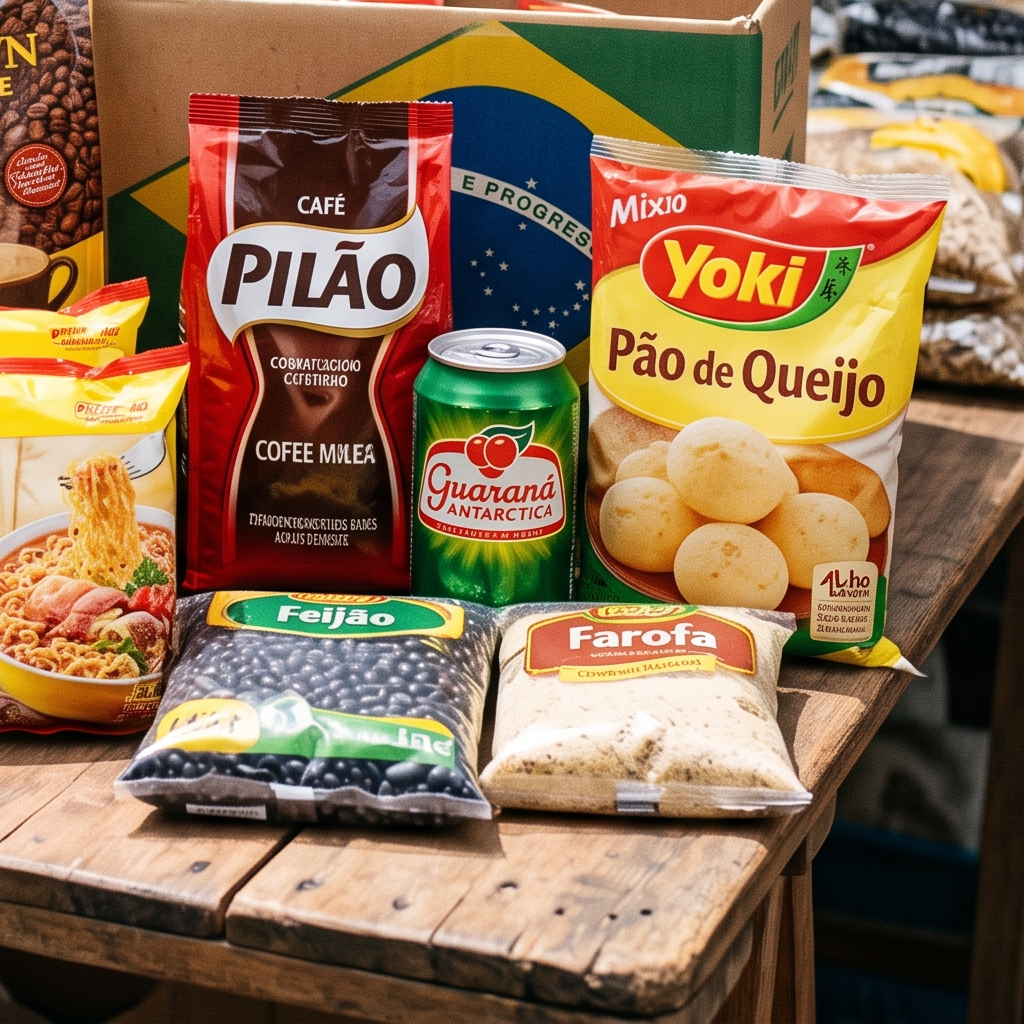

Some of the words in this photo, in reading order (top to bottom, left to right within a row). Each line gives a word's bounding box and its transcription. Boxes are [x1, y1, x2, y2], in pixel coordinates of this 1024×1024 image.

[297, 193, 346, 216] CAFÉ
[462, 175, 476, 191] E
[484, 181, 592, 255] PROGRES
[221, 241, 416, 312] PILÃO
[663, 239, 807, 309] Yoki
[608, 327, 686, 382] Pão
[692, 350, 734, 389] de
[742, 348, 886, 418] Queijo
[255, 439, 314, 464] COFEE
[427, 463, 557, 511] Guaraná
[447, 503, 553, 521] ANTARCTICA
[276, 605, 395, 630] Feijão
[569, 622, 717, 650] Farofa
